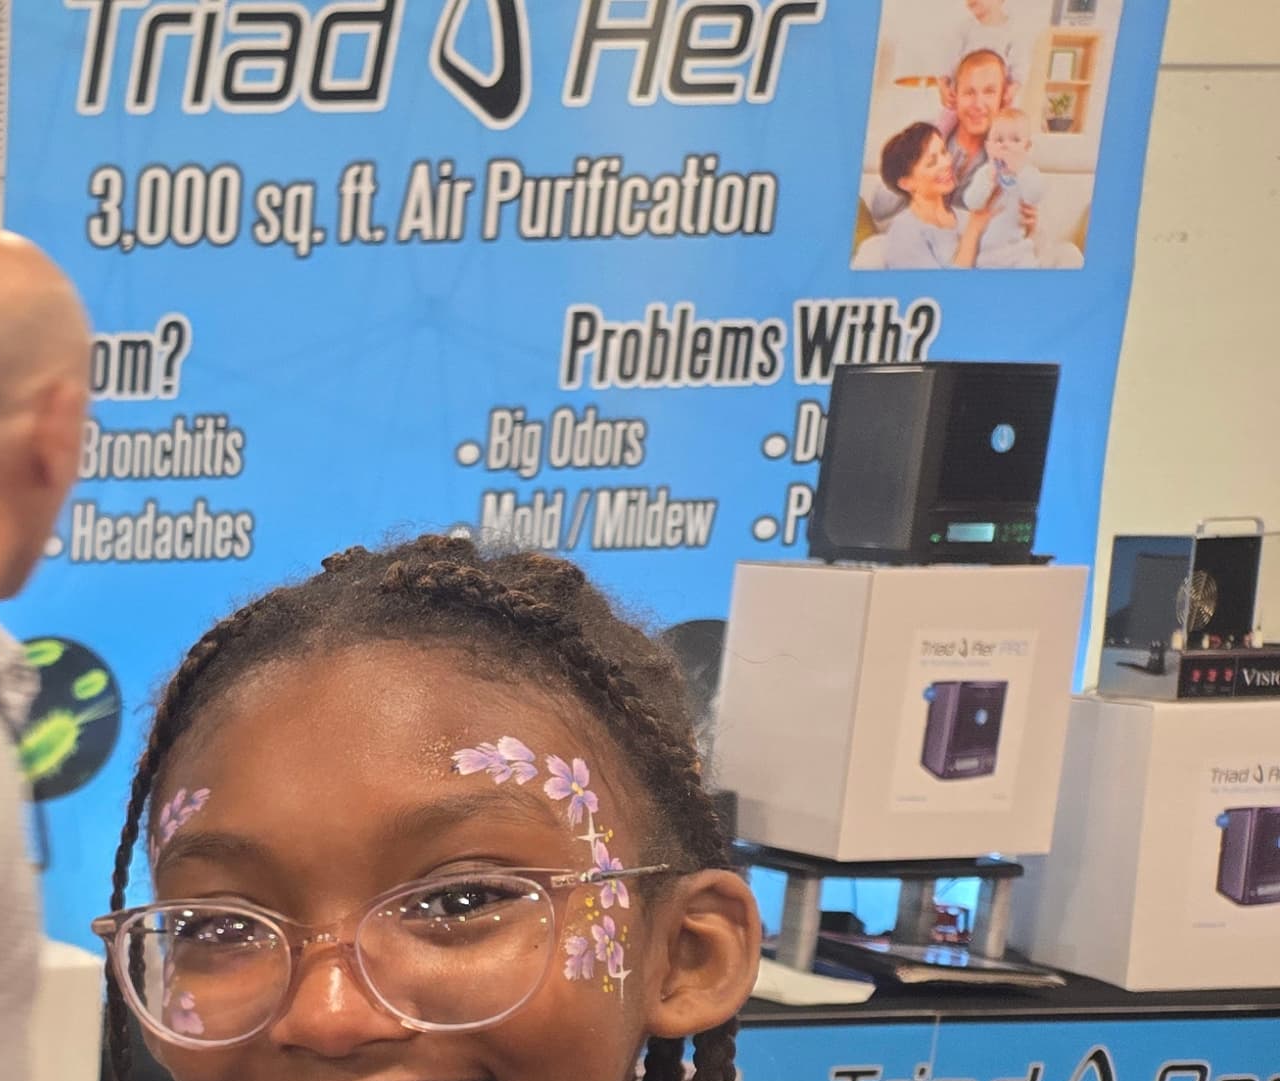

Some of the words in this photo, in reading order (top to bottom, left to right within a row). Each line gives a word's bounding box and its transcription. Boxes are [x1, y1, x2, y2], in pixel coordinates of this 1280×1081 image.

[65, 0, 402, 116] Triad
[561, 0, 824, 107] Aer
[87, 163, 240, 251] 3,000
[255, 177, 324, 258] sq.
[338, 159, 386, 245] ft.
[399, 157, 473, 243] Air
[485, 154, 778, 241] Purification
[88, 312, 193, 401] om?
[560, 303, 786, 391] Problems
[794, 298, 940, 385] With?
[78, 415, 245, 479] Bronchitis
[485, 406, 543, 478] Big
[549, 405, 645, 469] Odors
[794, 400, 828, 463] D
[70, 500, 254, 562] Headaches
[482, 490, 565, 550] Mold
[567, 489, 591, 550] /
[591, 485, 717, 549] Mildew
[784, 484, 814, 544] P
[1211, 767, 1249, 784] Triad
